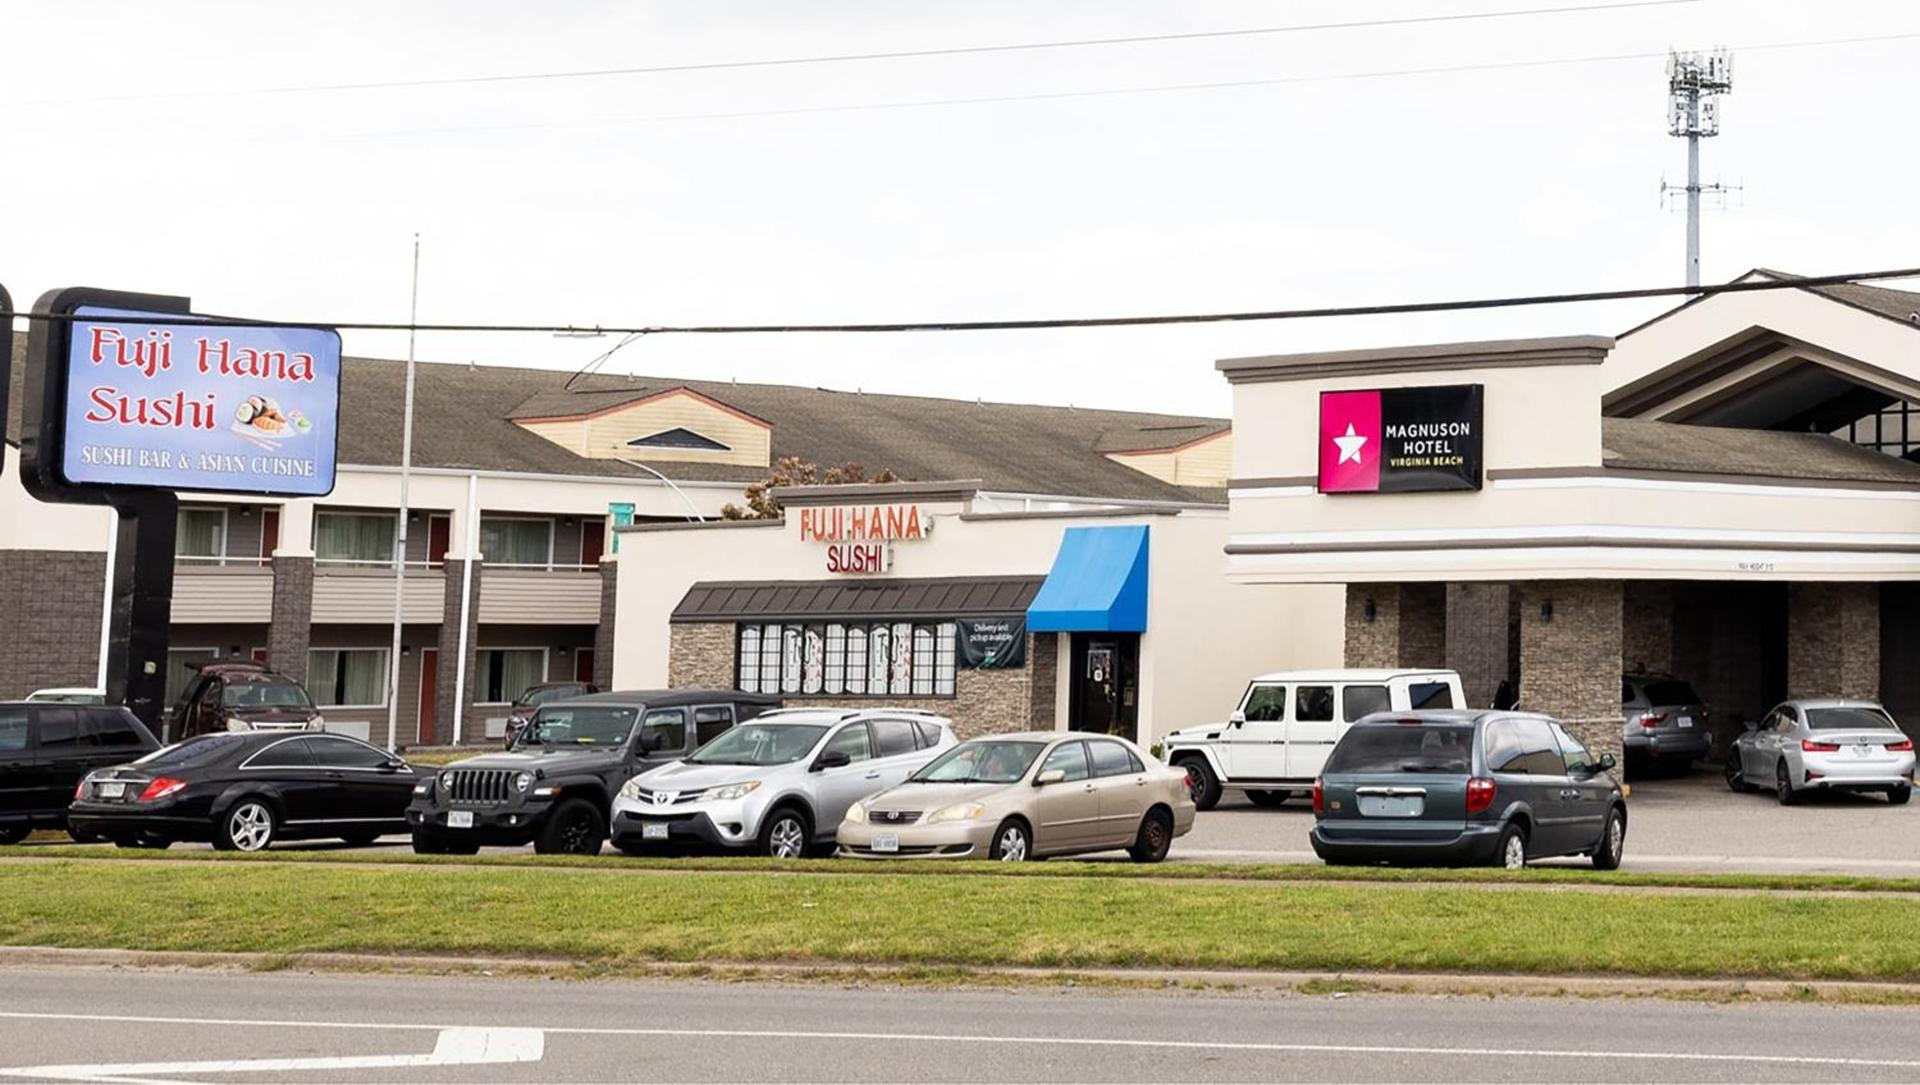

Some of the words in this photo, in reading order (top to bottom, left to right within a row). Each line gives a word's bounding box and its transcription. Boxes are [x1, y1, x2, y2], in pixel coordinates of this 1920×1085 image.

[91, 327, 172, 378] Fuji
[198, 338, 315, 382] Hana
[86, 387, 215, 430] Sushi
[1386, 423, 1470, 438] MAGNUSON
[82, 446, 132, 467] SUSHI
[139, 450, 171, 469] BAR
[178, 454, 190, 470] &
[198, 454, 245, 473] ASIAN
[251, 456, 314, 477] CUISINE
[1391, 457, 1430, 467] VIRGINIA
[1434, 456, 1463, 466] BEACH
[1404, 441, 1452, 454] HOTEL
[801, 507, 843, 541] FUJI
[852, 505, 921, 540] HANA
[827, 544, 882, 573] SUSHI
